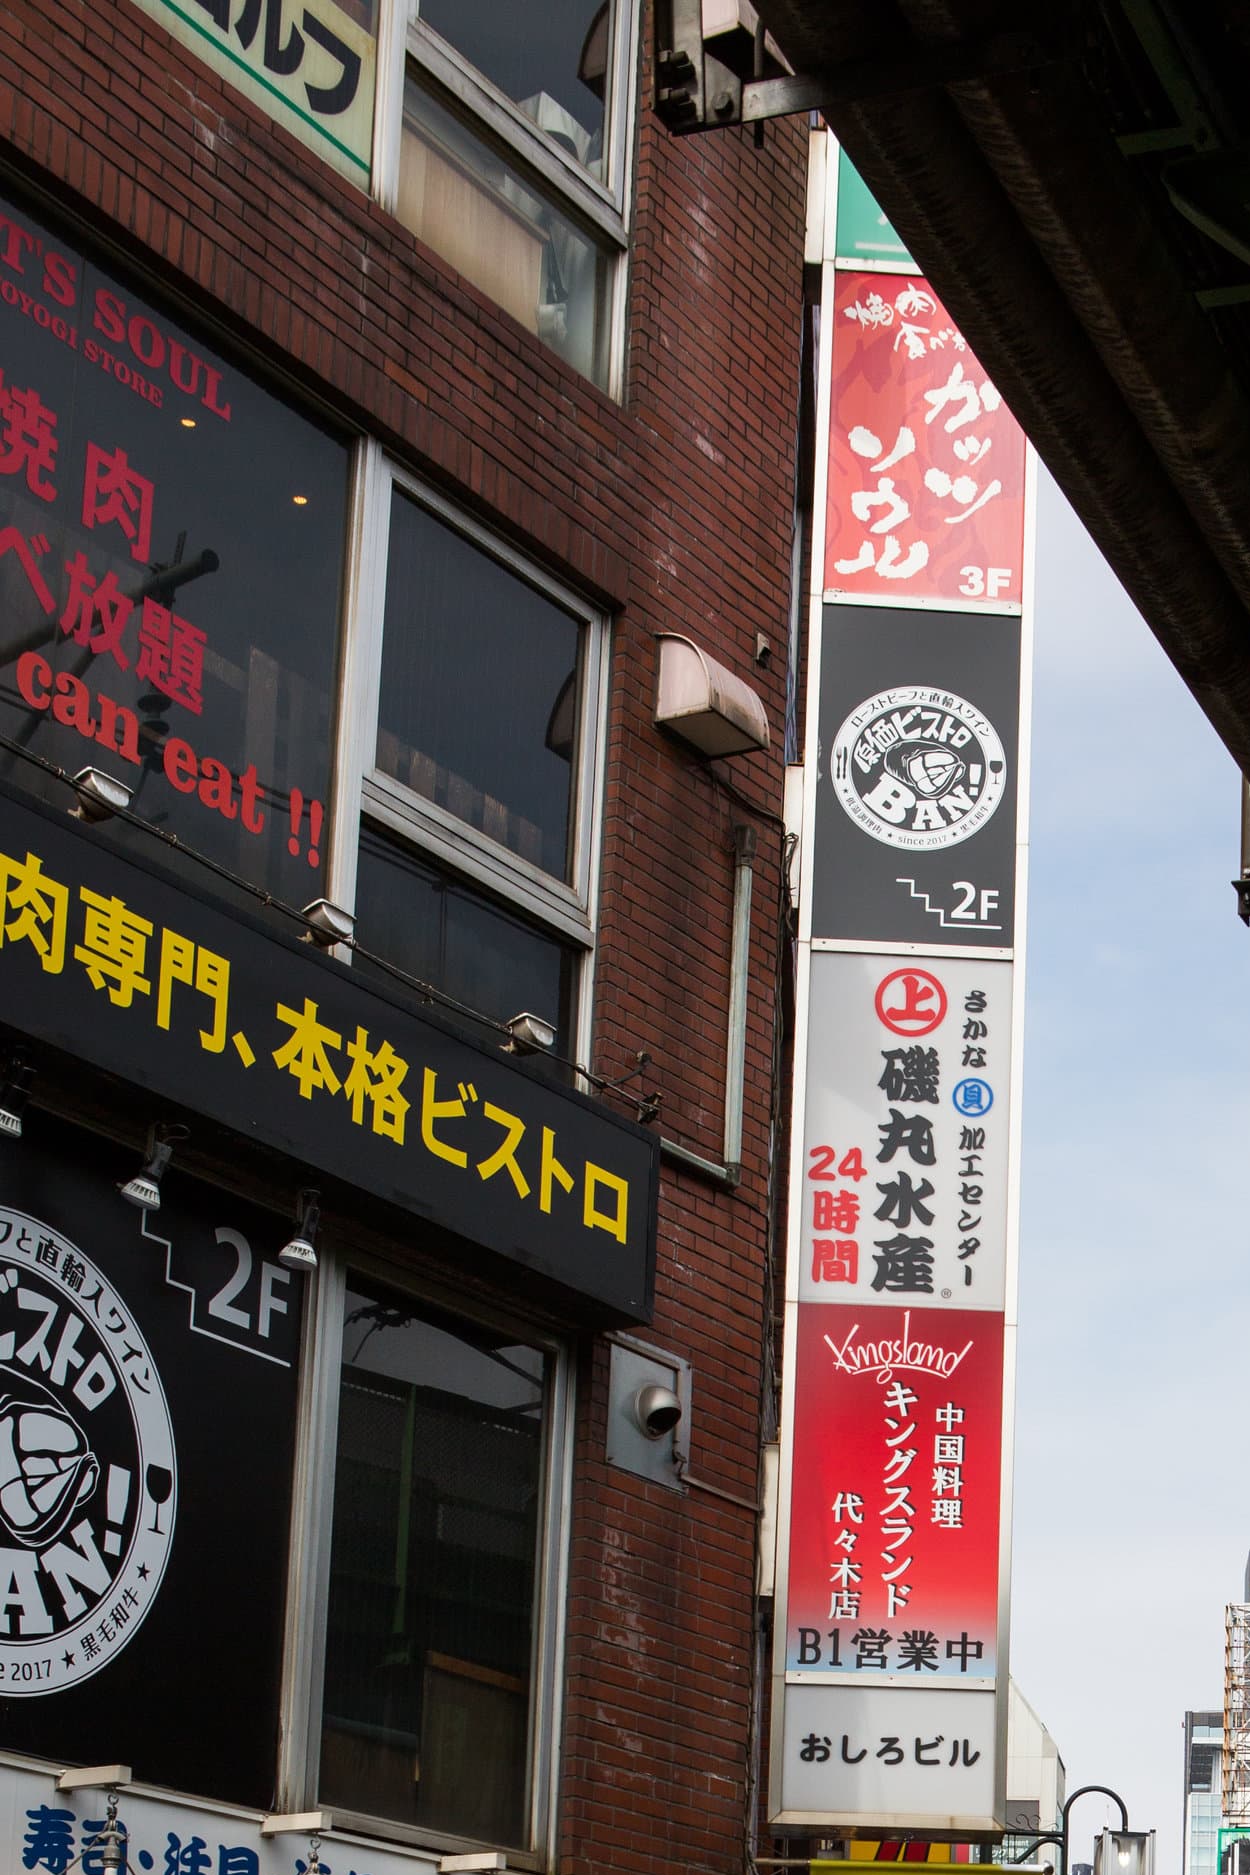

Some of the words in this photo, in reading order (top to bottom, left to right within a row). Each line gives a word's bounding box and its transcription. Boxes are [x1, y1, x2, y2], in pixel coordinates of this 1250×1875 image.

[84, 338, 164, 409] STORE
[94, 287, 231, 420] SOUL
[958, 566, 1013, 598] 3F
[16, 650, 141, 767] can
[163, 736, 266, 834] eat
[950, 881, 1000, 921] 2F
[0, 850, 630, 1245] 肉専門、本格ビストロ
[870, 1046, 941, 1294] 磯丸水産
[206, 1226, 291, 1339] 2F
[824, 1311, 974, 1384] Kingsland
[879, 1381, 920, 1620] キングスランド
[930, 1402, 966, 1530] 中国料理
[828, 1492, 866, 1621] 代々木店
[11, 1659, 52, 1682] 2017
[79, 1586, 140, 1662] 黒毛和牛
[799, 1733, 982, 1769] おしろビル
